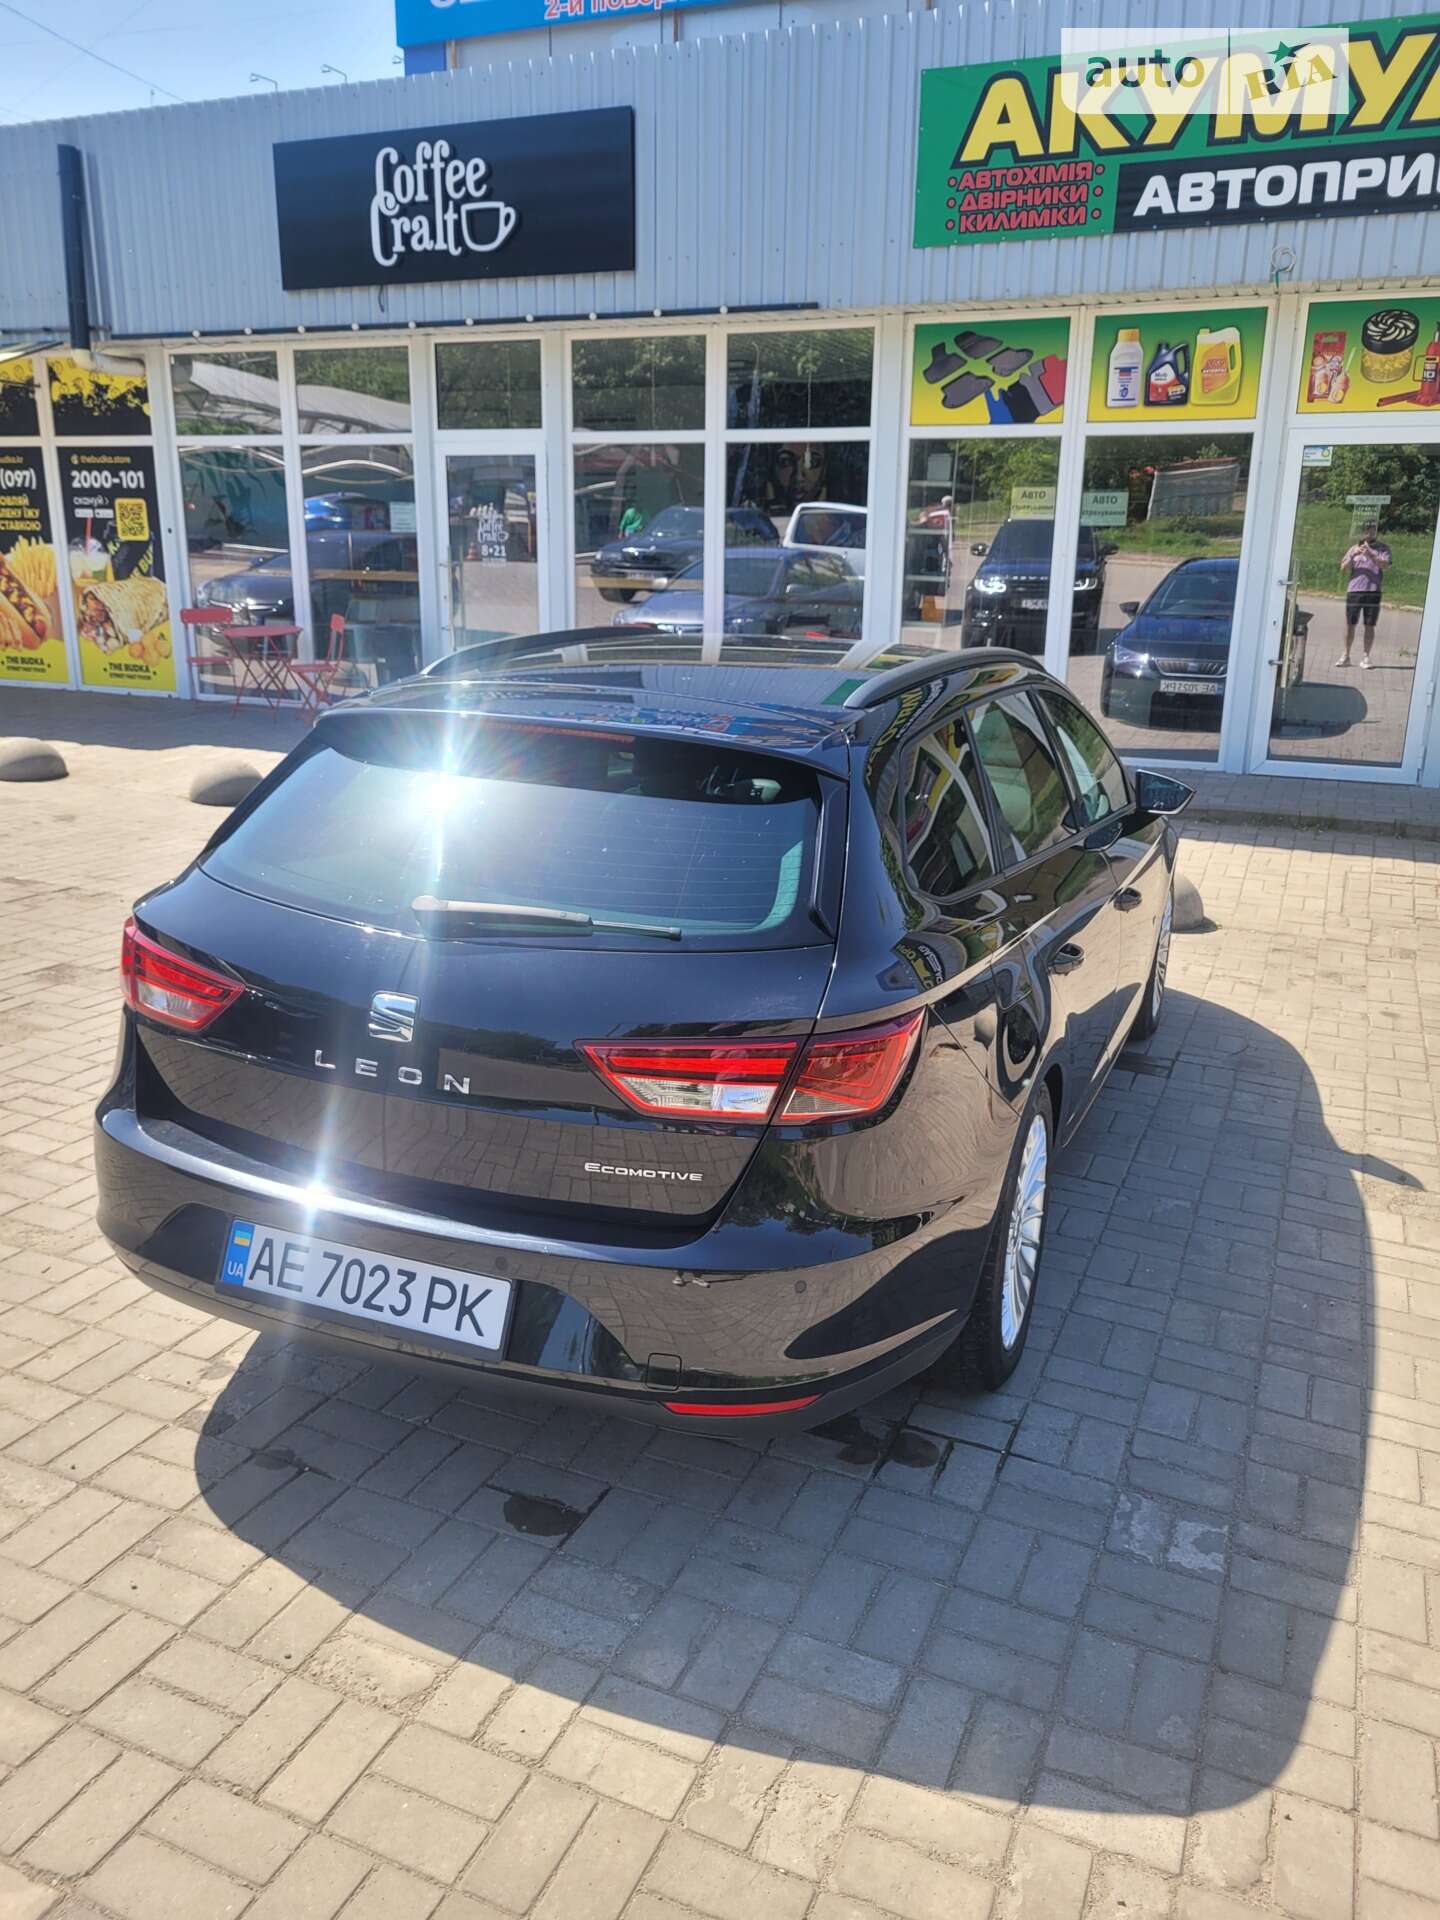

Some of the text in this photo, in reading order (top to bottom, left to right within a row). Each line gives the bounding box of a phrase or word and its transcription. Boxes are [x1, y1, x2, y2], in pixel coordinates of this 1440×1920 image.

[374, 139, 488, 216] Coffee
[958, 161, 1093, 190] АВТОХІМІЯ
[1133, 151, 1440, 217] АВТОПРИ
[959, 184, 1088, 212] ДВІРНИКИ
[959, 206, 1087, 234] КИЛИМКИ
[0, 467, 38, 490] (097)
[70, 470, 145, 489] 2000-101
[315, 1049, 471, 1095] LEON
[227, 1261, 244, 1277] UA
[249, 1237, 493, 1337] AE 7023 PK
